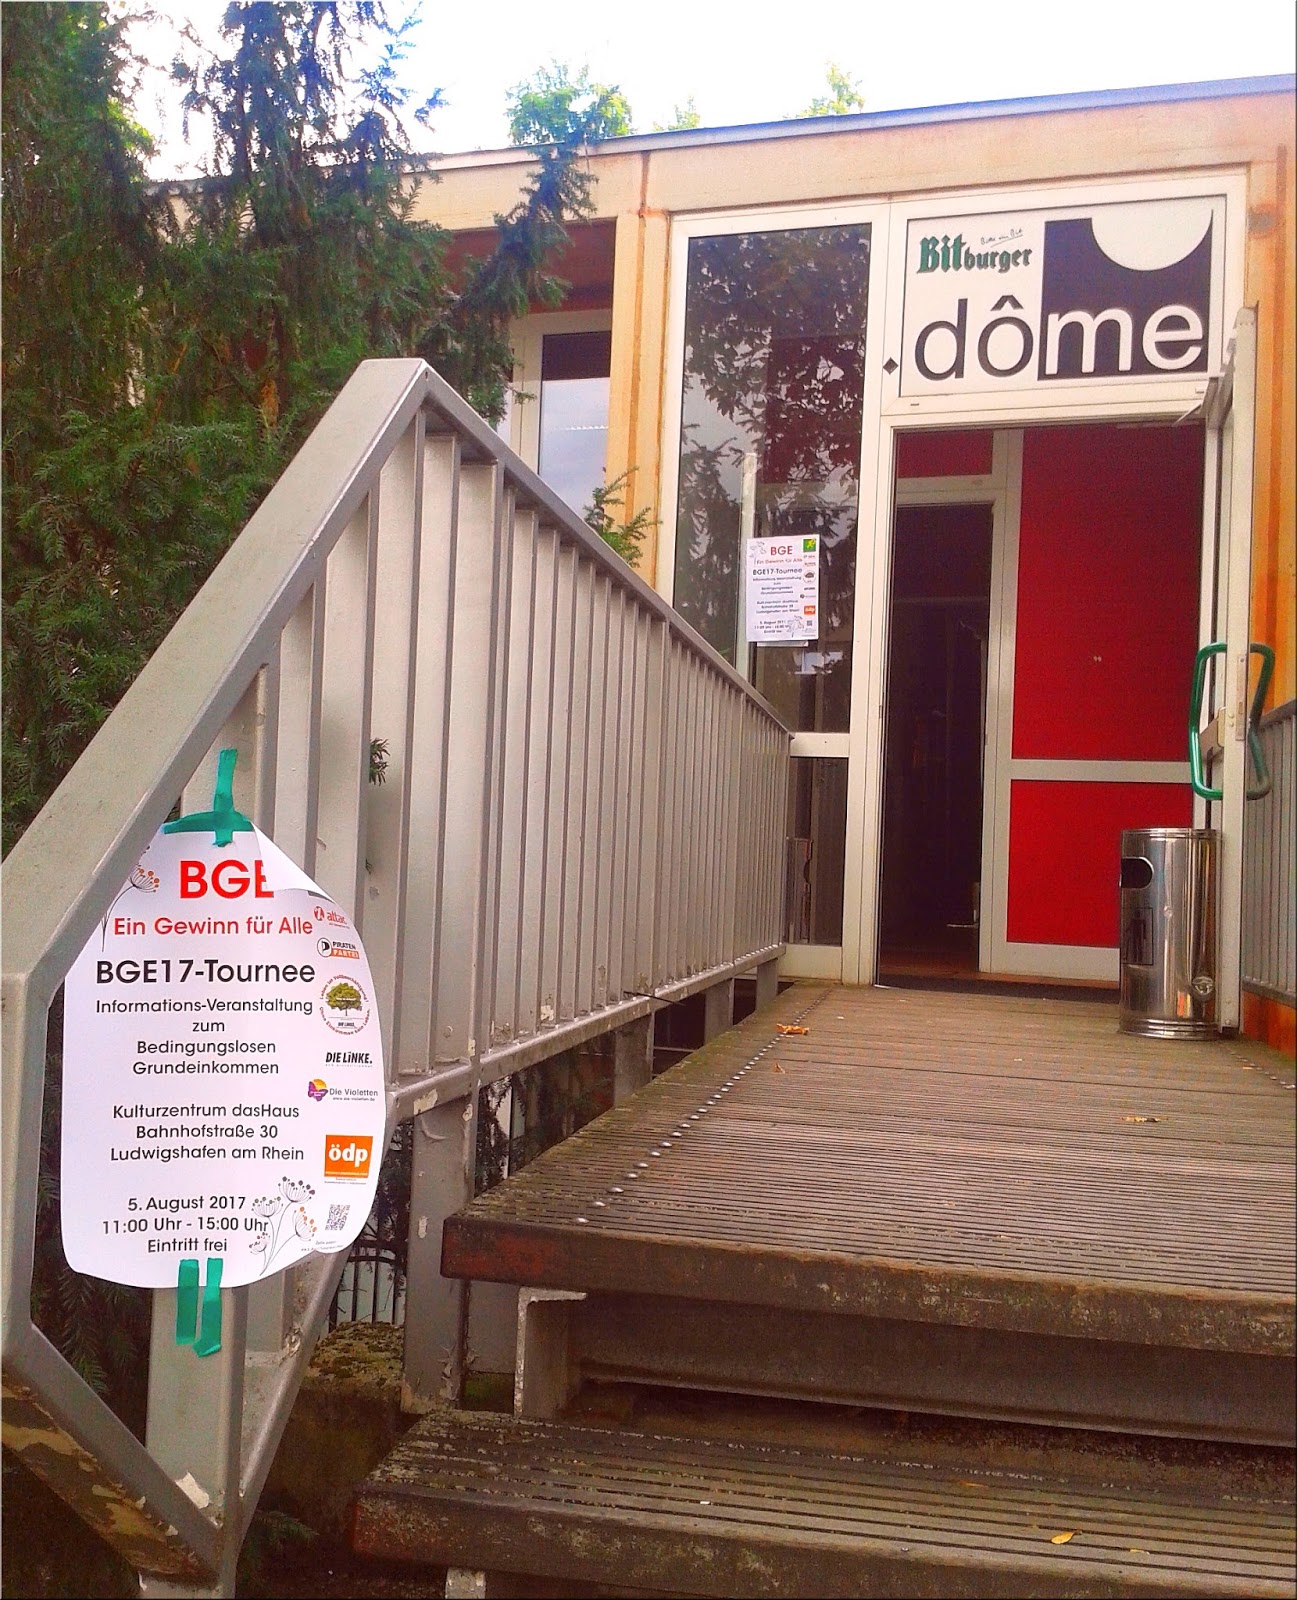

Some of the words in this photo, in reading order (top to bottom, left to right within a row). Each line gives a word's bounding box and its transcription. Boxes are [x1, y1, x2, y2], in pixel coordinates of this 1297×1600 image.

[916, 234, 1032, 274] Bitburger
[914, 294, 1203, 381] dôme
[770, 546, 793, 556] BGE
[180, 860, 274, 900] BGE
[114, 918, 146, 935] Ein
[154, 917, 240, 935] Gewinn
[246, 916, 273, 934] für
[278, 916, 313, 934] Alle
[332, 941, 356, 950] PIRATEN
[333, 950, 358, 958] PARTEI
[96, 960, 316, 984] BGE17-Tournee
[96, 998, 313, 1016] Informations-Veranstaltung
[192, 1021, 225, 1032] zum
[137, 1040, 276, 1056] Bedingungslosen
[326, 1052, 342, 1063] DIE
[132, 1060, 279, 1074] Grundeinkommen
[329, 1088, 342, 1096] Die
[344, 1088, 378, 1096] Violetten
[113, 1104, 227, 1119] Kulturzentrum
[232, 1104, 300, 1118] dasHaus
[136, 1124, 255, 1139] Bahnhofstraße
[260, 1124, 278, 1138] 30
[110, 1146, 226, 1162] Ludwigshafen
[231, 1148, 256, 1159] am
[262, 1146, 304, 1160] Rhein
[328, 1142, 368, 1168] ödp
[127, 1198, 142, 1212] 5.
[146, 1196, 204, 1213] August
[209, 1196, 246, 1210] 2017
[102, 1218, 148, 1234] 11:00
[154, 1218, 182, 1232] Uhr
[197, 1217, 239, 1231] 15:00
[244, 1218, 269, 1232] Uhr
[148, 1238, 198, 1253] Eintritt
[204, 1237, 228, 1252] frei
